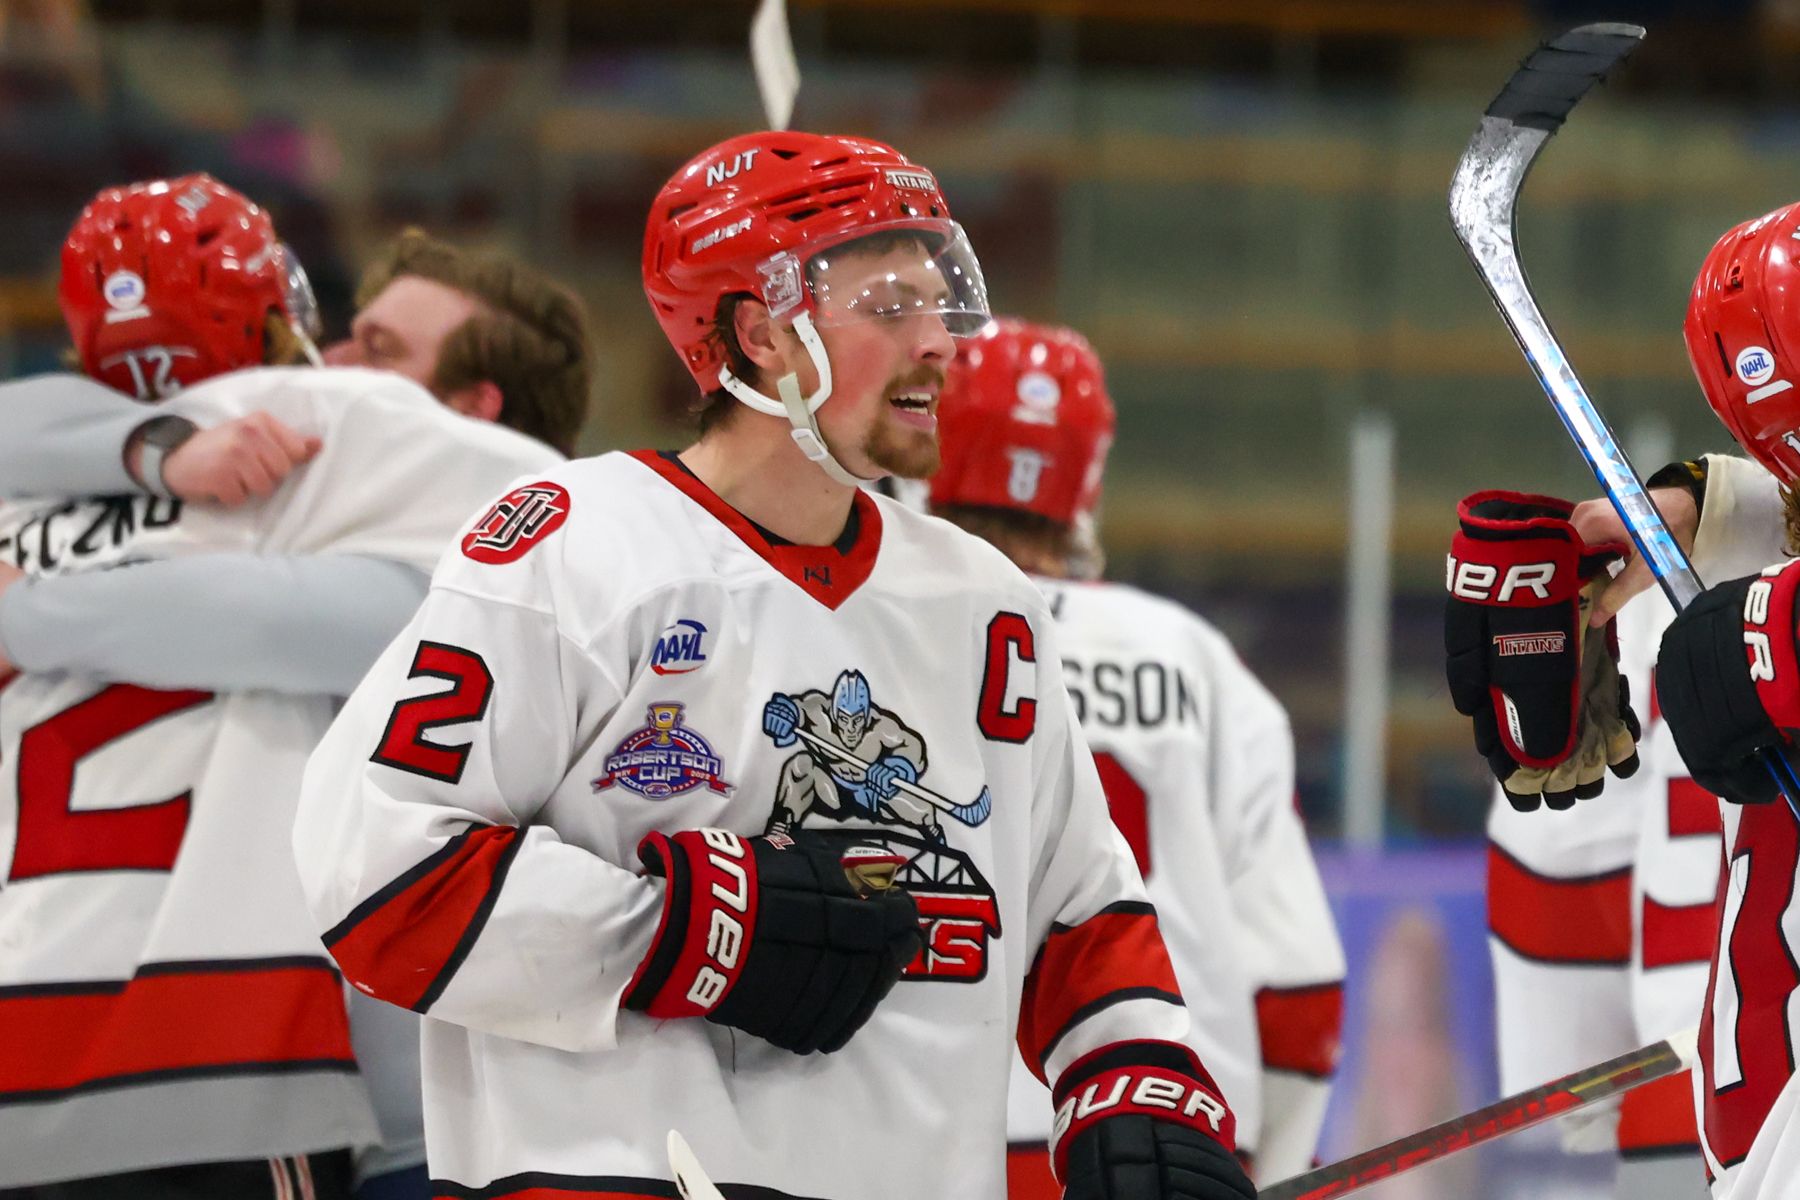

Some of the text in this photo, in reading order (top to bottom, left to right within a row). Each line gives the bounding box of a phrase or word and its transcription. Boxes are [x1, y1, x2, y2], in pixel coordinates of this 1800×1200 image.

[706, 149, 760, 188] NJT
[886, 170, 936, 191] TITANS
[1740, 354, 1769, 378] NAHL
[651, 633, 706, 666] NAHL
[1493, 631, 1566, 656] TITANS
[976, 610, 1037, 745] C
[370, 640, 494, 785] 2
[607, 750, 720, 775] ROBERTSON
[639, 766, 681, 782] CUP
